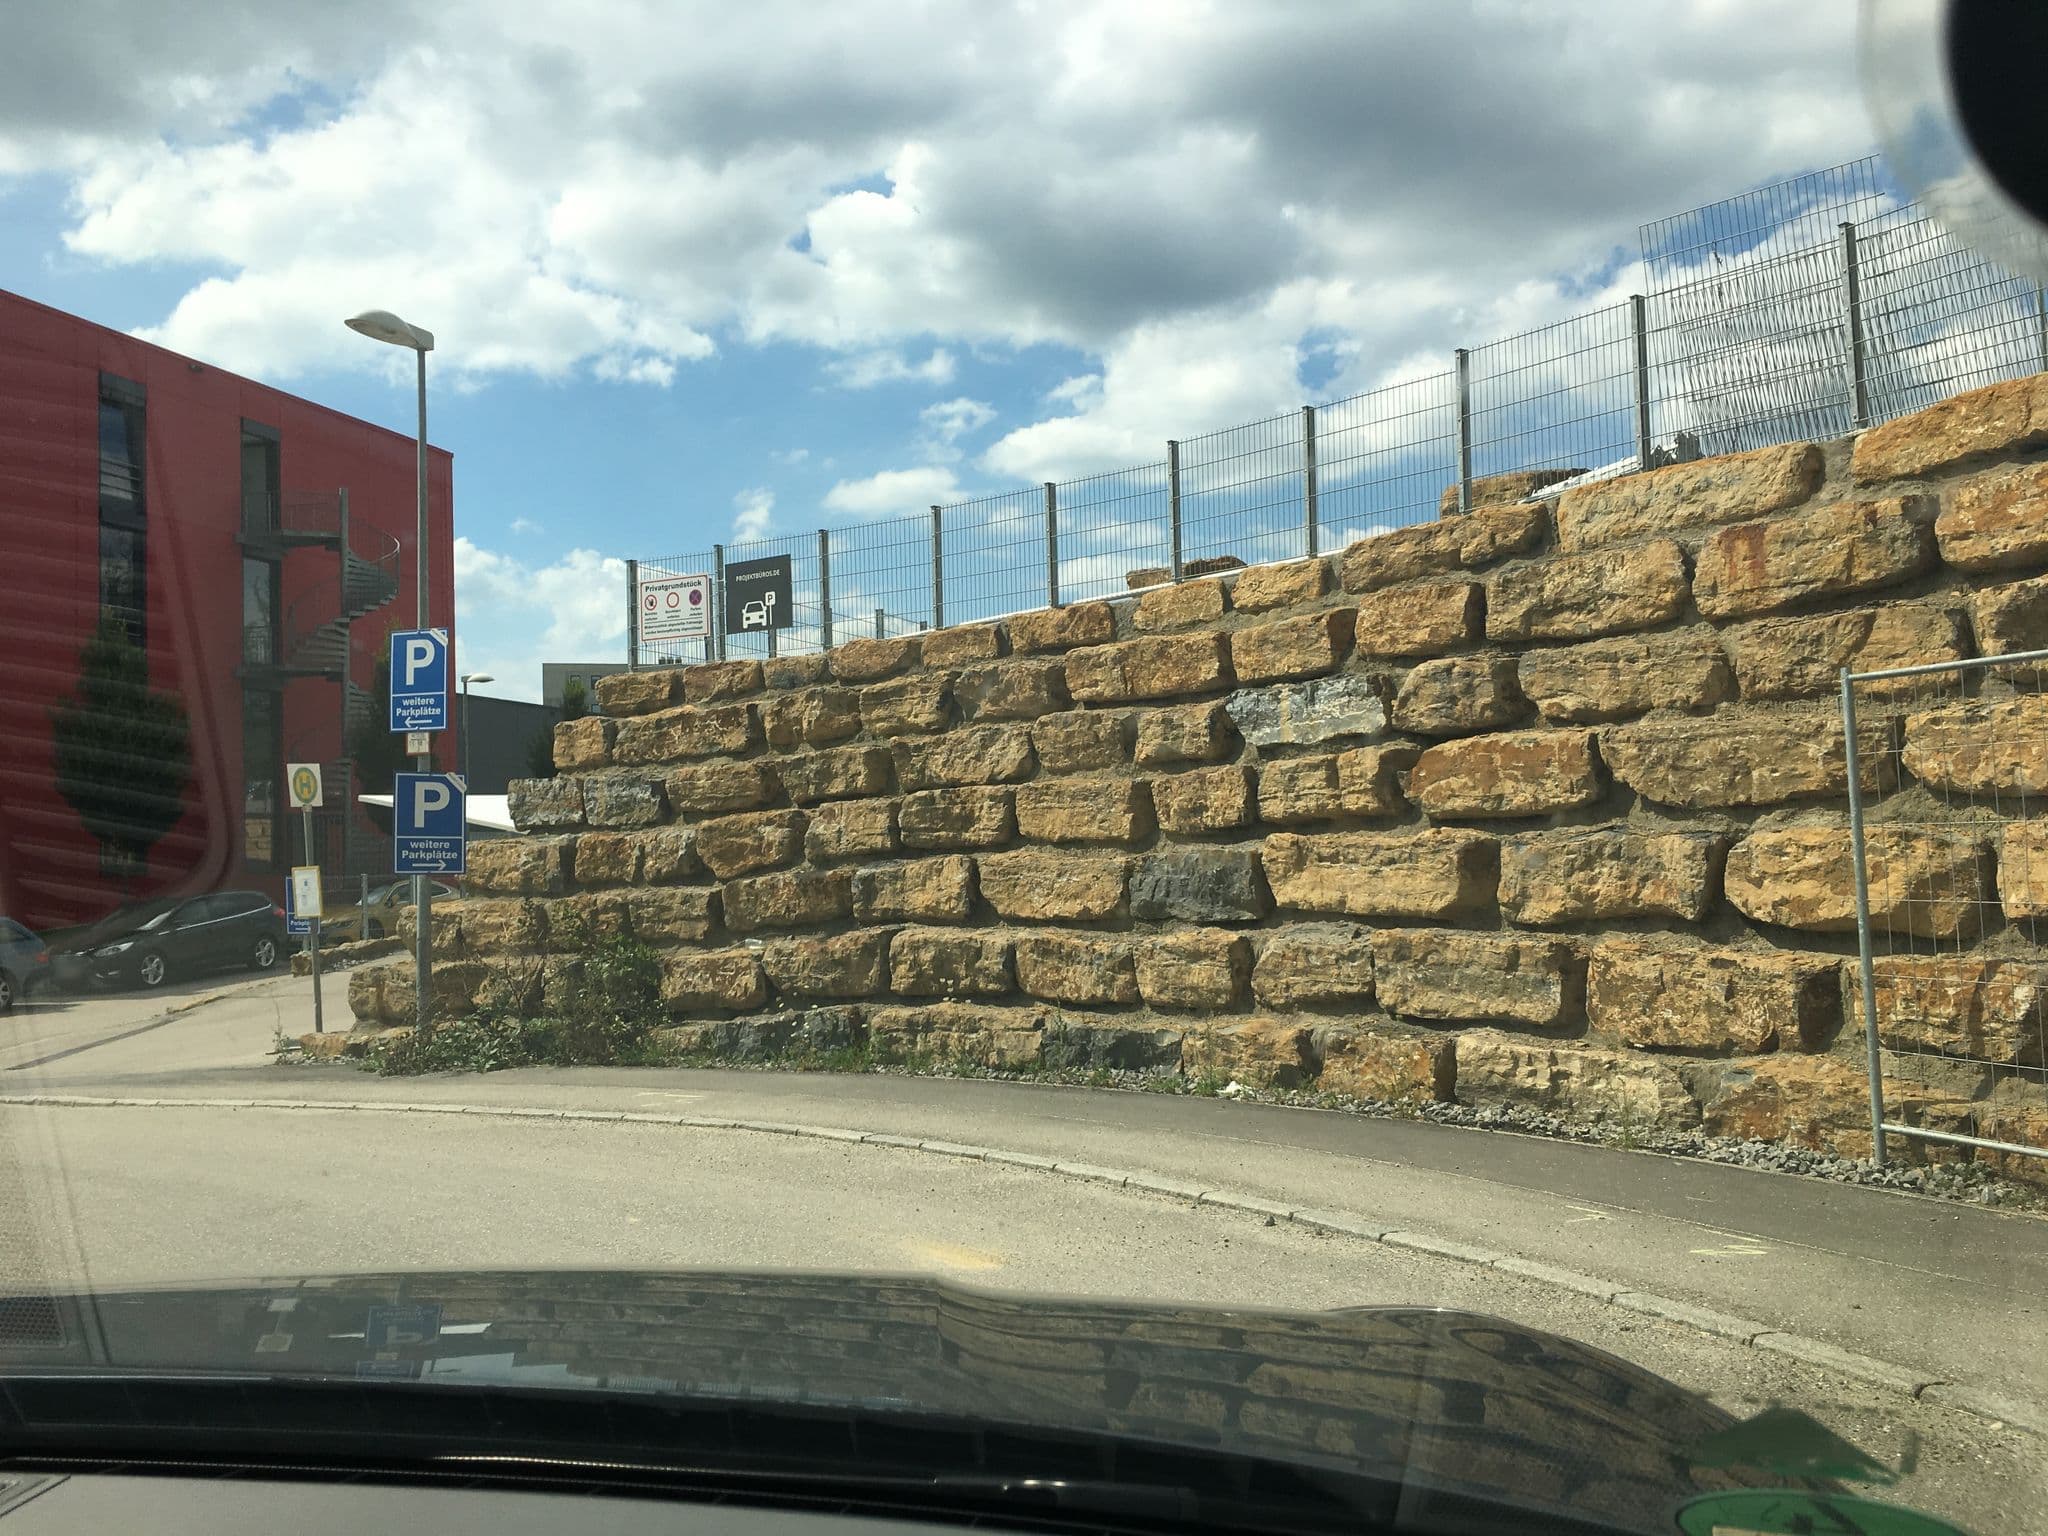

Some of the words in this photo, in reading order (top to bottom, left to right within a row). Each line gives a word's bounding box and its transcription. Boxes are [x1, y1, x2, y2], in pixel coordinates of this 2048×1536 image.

[645, 580, 702, 592] Privatgrundstück
[406, 639, 435, 685] P
[402, 697, 435, 706] weitere
[396, 707, 441, 718] Parkplätze
[414, 781, 450, 828] P
[410, 840, 450, 849] weitere
[401, 850, 458, 860] Parkplätze
